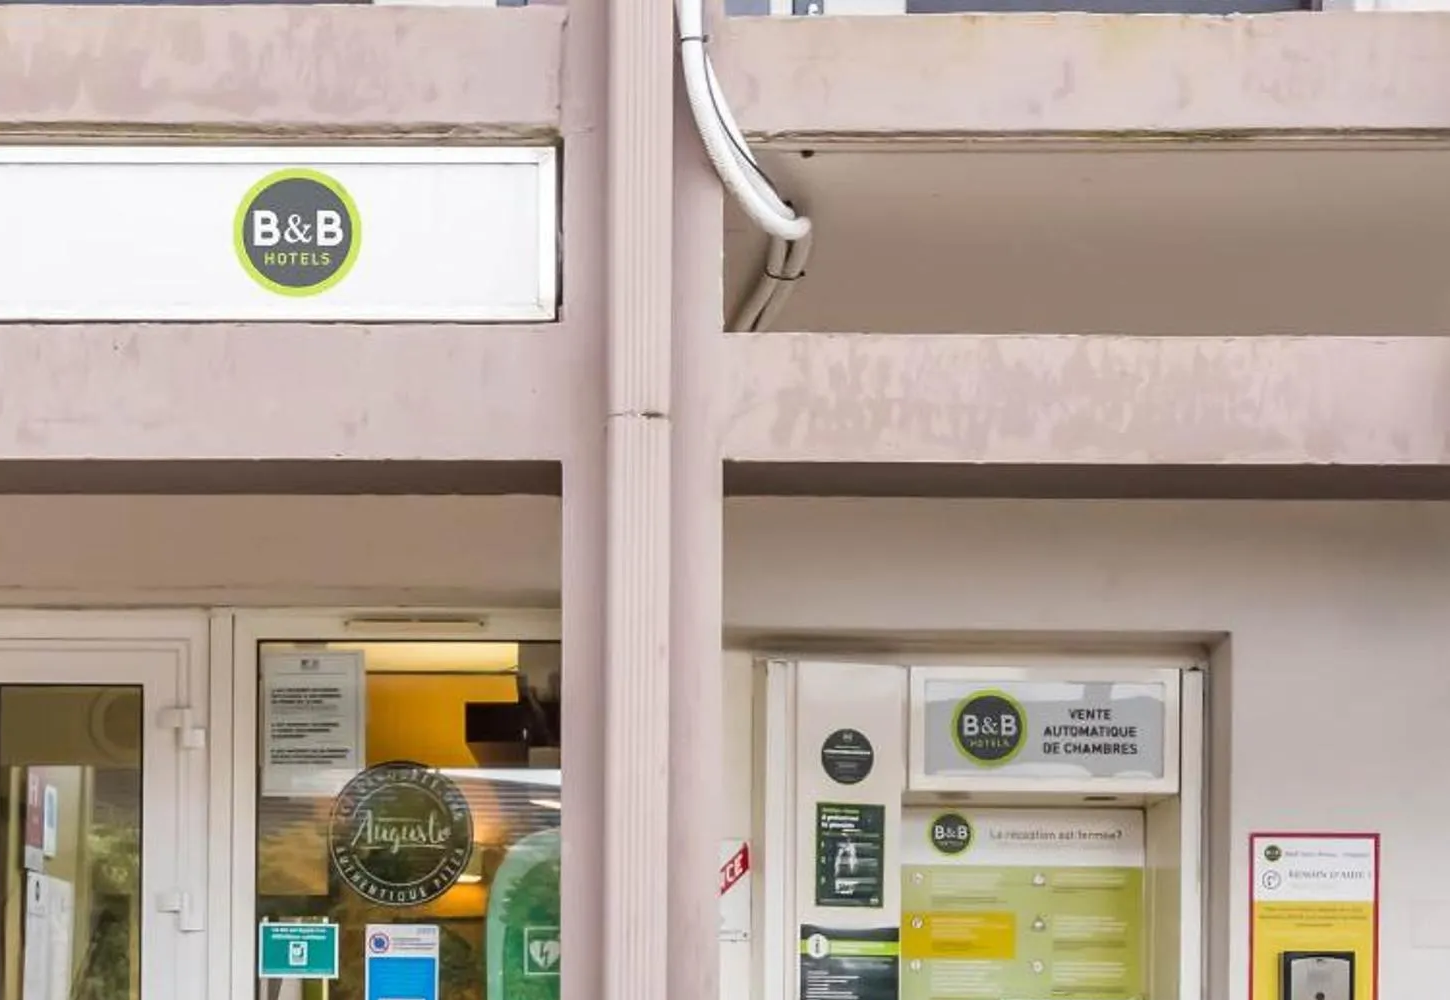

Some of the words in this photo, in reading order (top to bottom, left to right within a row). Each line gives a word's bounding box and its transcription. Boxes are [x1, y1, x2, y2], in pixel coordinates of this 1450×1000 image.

[253, 210, 343, 246] B&B
[264, 252, 331, 266] HOTELS
[1068, 708, 1111, 721] VENTE
[963, 714, 1017, 736] B&B
[1043, 725, 1138, 739] AUTOMATIQUE
[1042, 742, 1060, 755] DE
[1063, 742, 1138, 756] CHAMBRES
[934, 824, 968, 840] B&B
